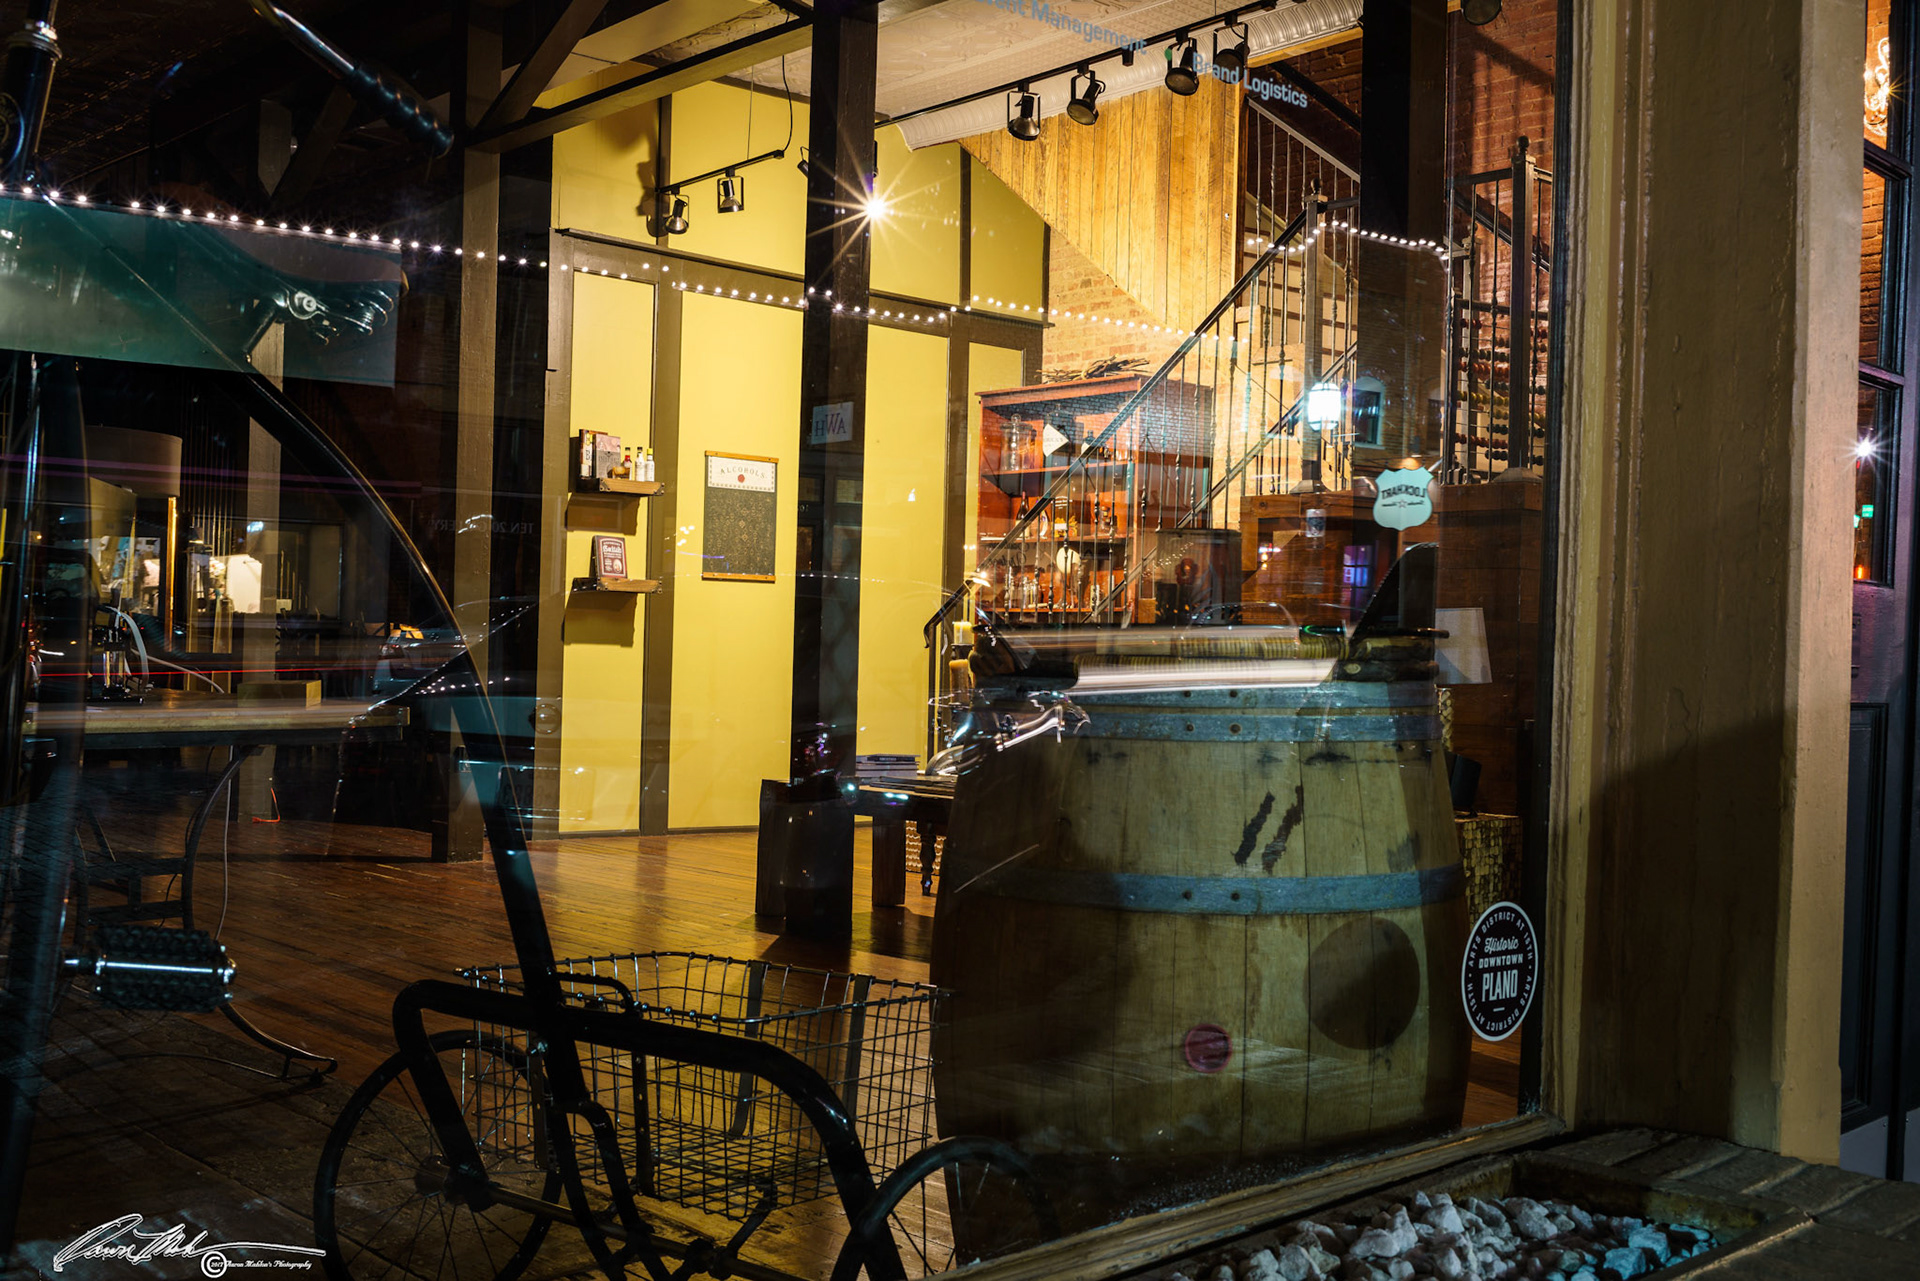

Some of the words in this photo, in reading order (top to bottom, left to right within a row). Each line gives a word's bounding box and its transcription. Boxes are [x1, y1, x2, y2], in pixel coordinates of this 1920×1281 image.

[976, 0, 1027, 16] ent
[1031, 0, 1147, 55] Management
[1192, 51, 1240, 85] Brand
[1243, 69, 1308, 109] Logistics
[1468, 935, 1481, 967] ARTS
[1481, 911, 1515, 933] DISTRICT
[1516, 919, 1525, 931] AT
[1484, 936, 1519, 954] Historic
[1478, 953, 1524, 969] DOWNTOWN
[1481, 969, 1519, 1002] PLANO
[1485, 1008, 1520, 1031] DISTRICT
